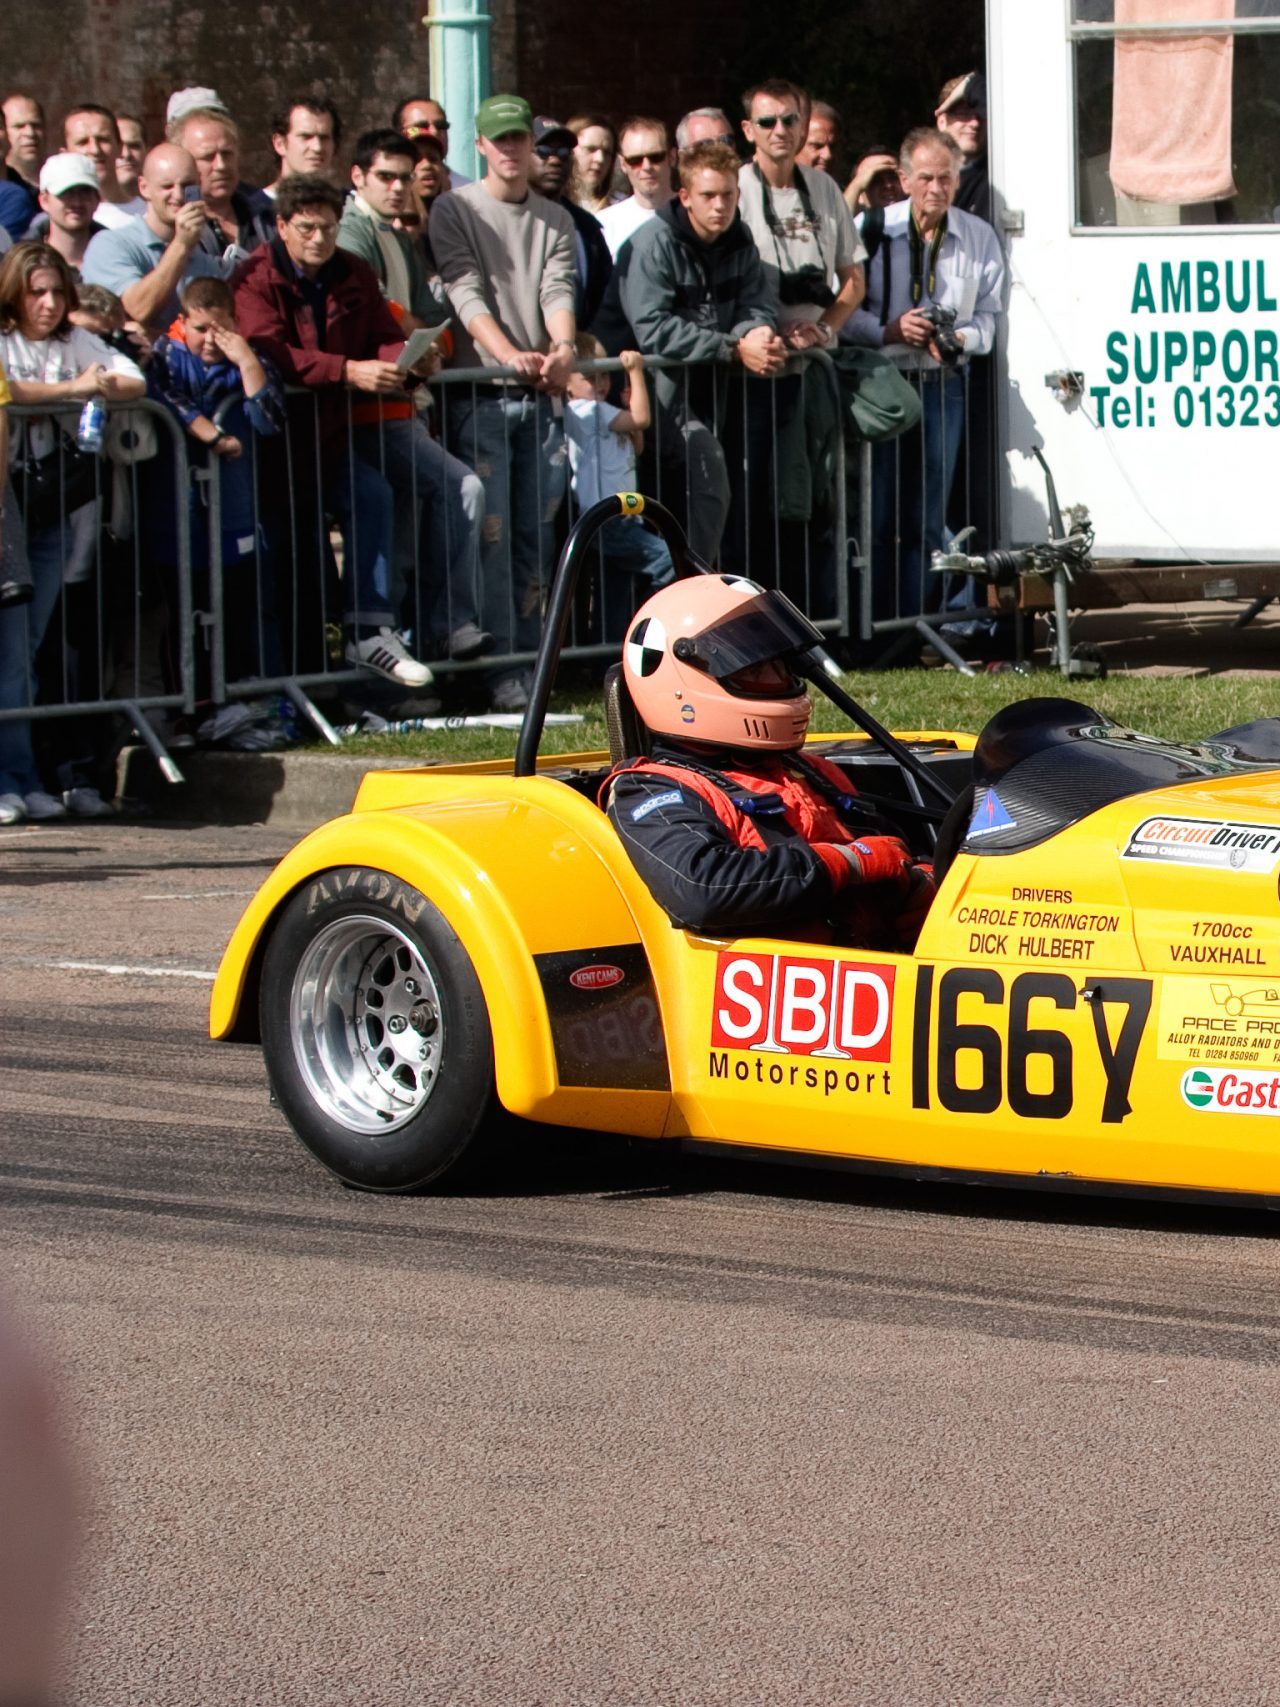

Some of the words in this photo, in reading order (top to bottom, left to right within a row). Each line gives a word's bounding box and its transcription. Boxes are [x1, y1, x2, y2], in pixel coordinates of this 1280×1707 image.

[1090, 386, 1156, 428] Tel:
[1130, 843, 1158, 854] SPEED
[306, 871, 428, 922] AVON
[1012, 887, 1072, 904] DRIVERS
[957, 907, 1017, 927] CAROLE
[1021, 911, 1120, 932] TORKINGTON
[1191, 922, 1253, 938] 1700cc
[969, 933, 1007, 955] DICK
[1019, 936, 1094, 961] HULBERT
[1170, 945, 1266, 965] VAUXHALL
[576, 971, 596, 985] KENT
[596, 968, 618, 983] CAMS
[718, 958, 890, 1050] SBD
[1182, 1017, 1237, 1031] PACE
[1168, 1033, 1195, 1044] ALLOY
[1198, 1034, 1248, 1048] RADIATORS
[1251, 1037, 1270, 1049] AND
[1189, 1048, 1200, 1058] TEL
[1205, 1049, 1228, 1060] 01284
[1230, 1051, 1259, 1062] 850960
[710, 1051, 891, 1096] Motorsport
